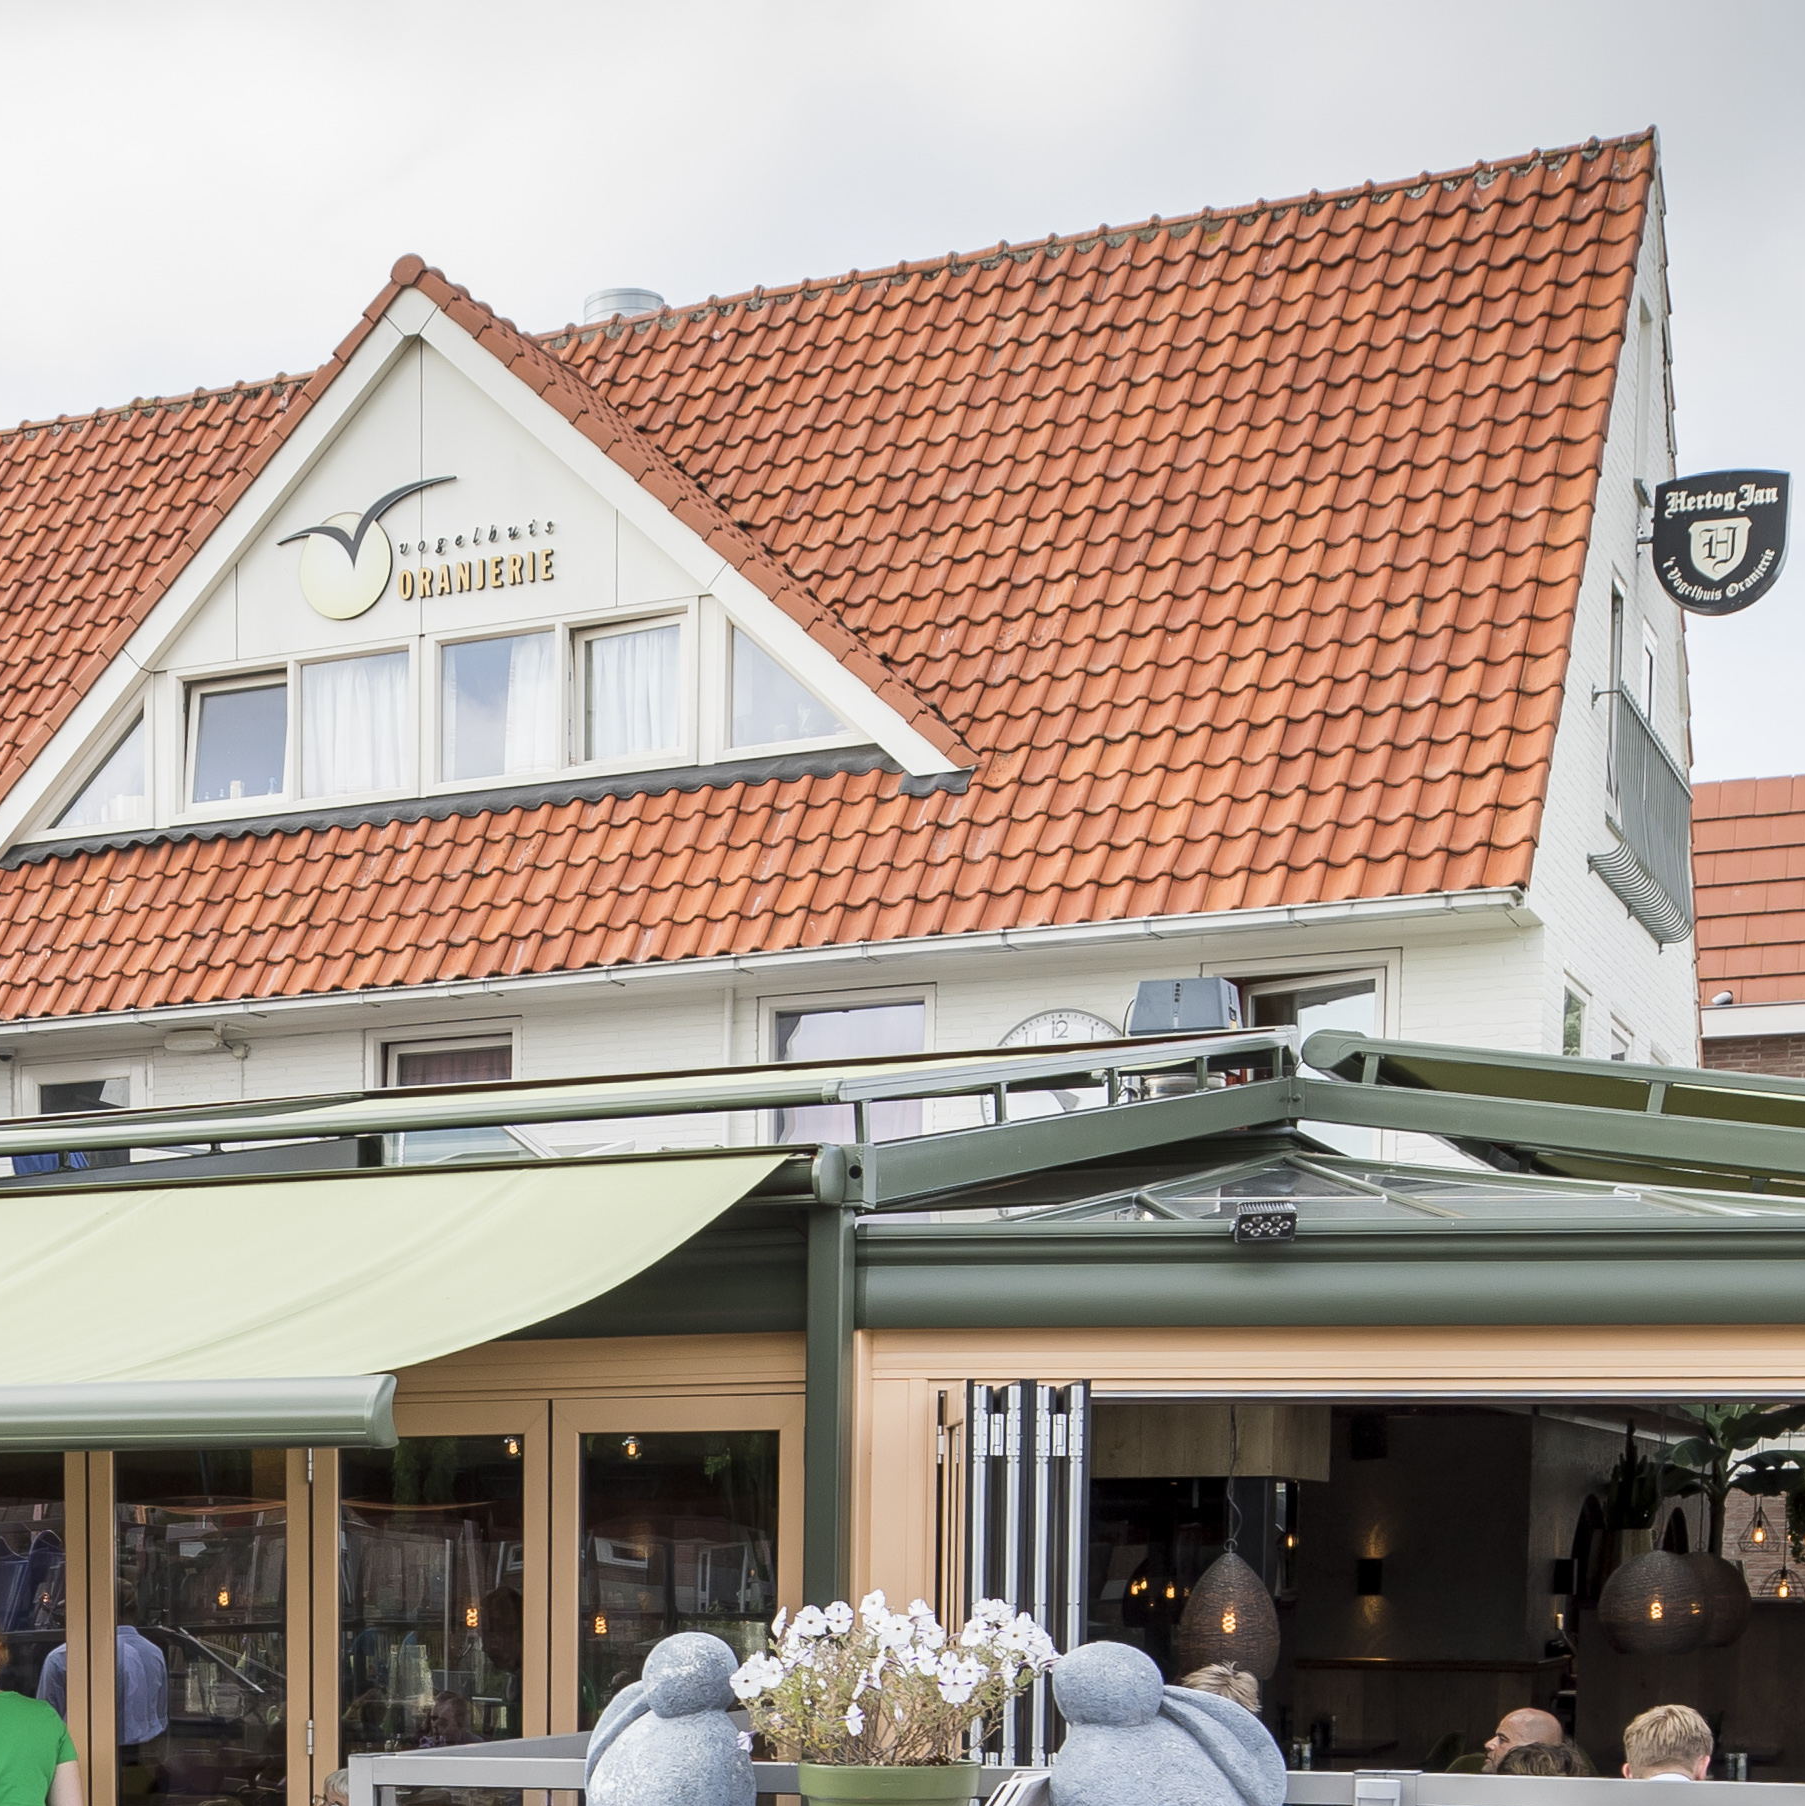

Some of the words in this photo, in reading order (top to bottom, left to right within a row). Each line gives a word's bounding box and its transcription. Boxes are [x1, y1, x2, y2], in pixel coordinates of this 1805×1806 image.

[1664, 489, 1737, 519] Hertog
[1737, 483, 1779, 512] Jan
[398, 518, 557, 555] vogelhuis
[398, 549, 555, 601] ORANJERIE
[1667, 567, 1723, 602] Vogelhuis
[1725, 548, 1776, 599] Oranjerie
[1051, 1020, 1068, 1039] 12
